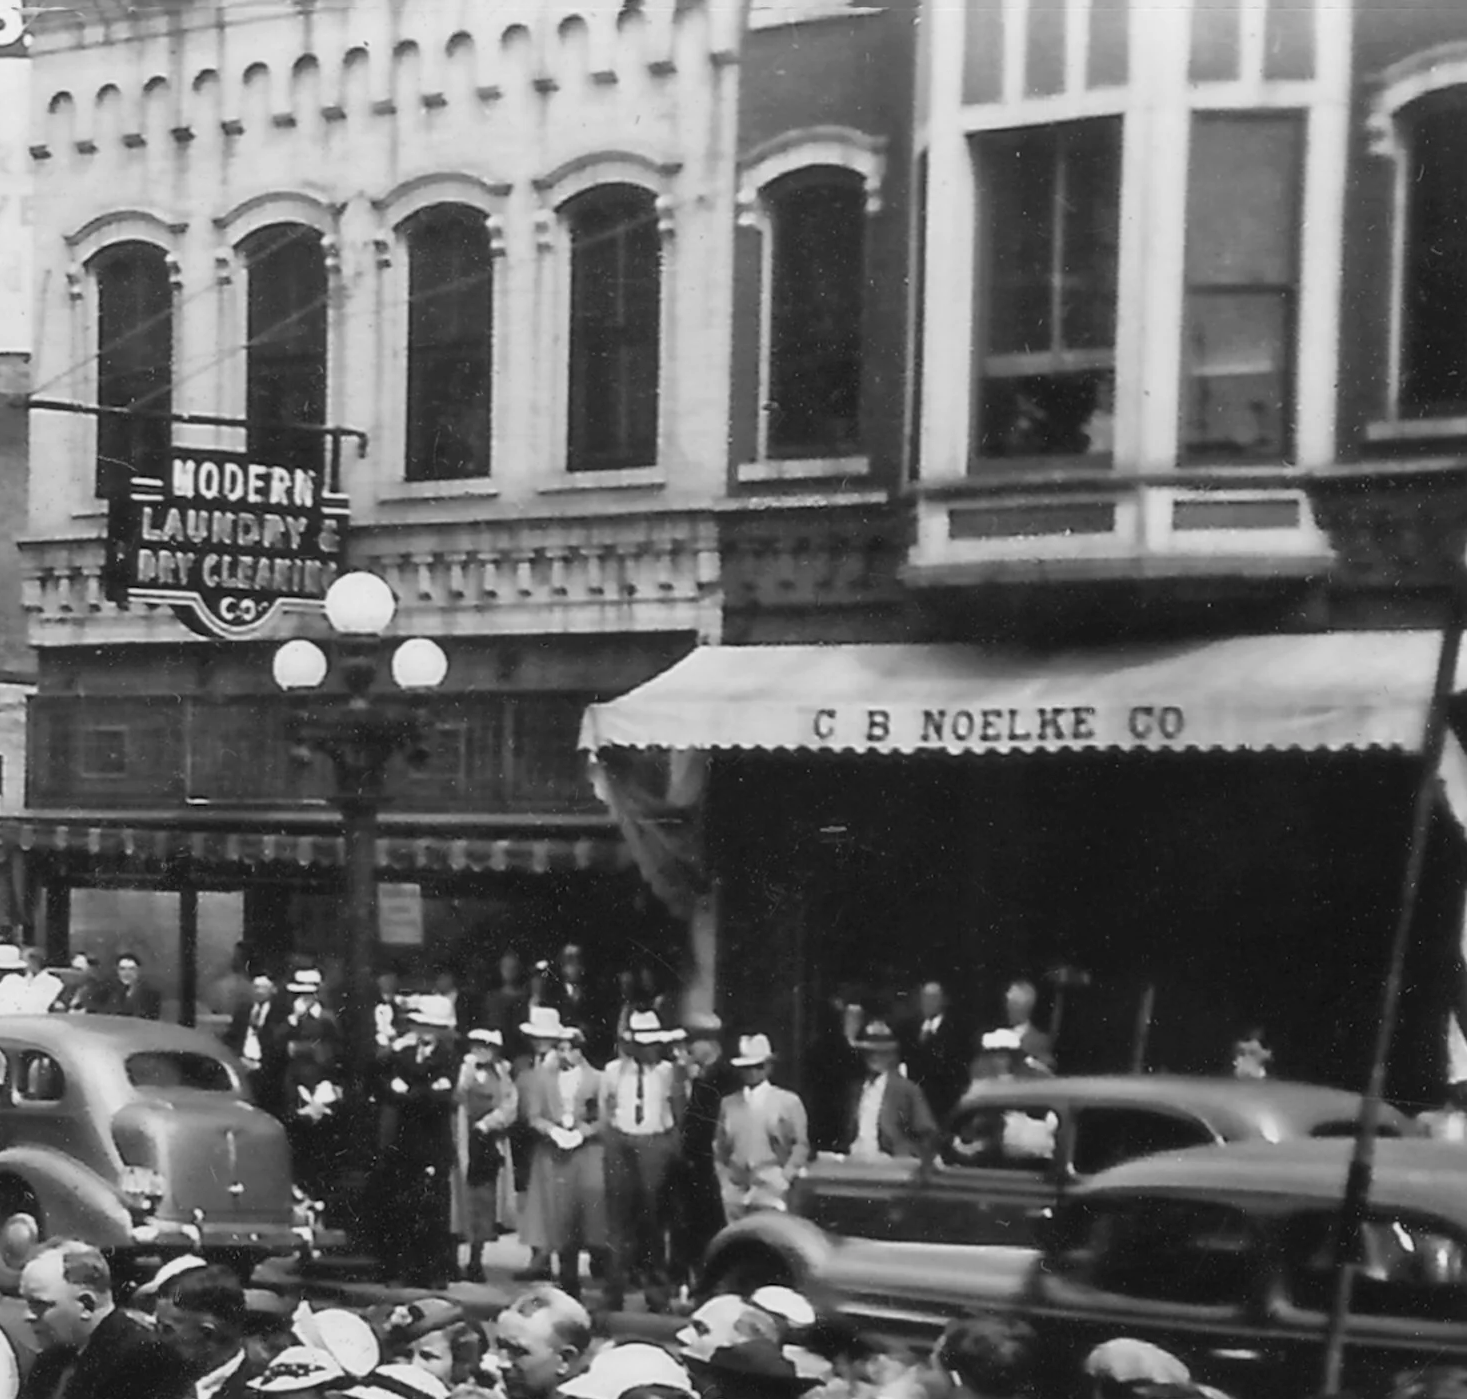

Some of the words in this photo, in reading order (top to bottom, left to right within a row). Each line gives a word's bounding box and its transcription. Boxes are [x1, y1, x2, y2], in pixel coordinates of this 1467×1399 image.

[172, 458, 317, 508] MODERN
[142, 505, 308, 549] LAUNDRY
[137, 548, 195, 586] DRY
[813, 708, 837, 740] C
[867, 709, 890, 742] B
[921, 706, 1096, 742] NOELKE
[1128, 705, 1184, 740] CO
